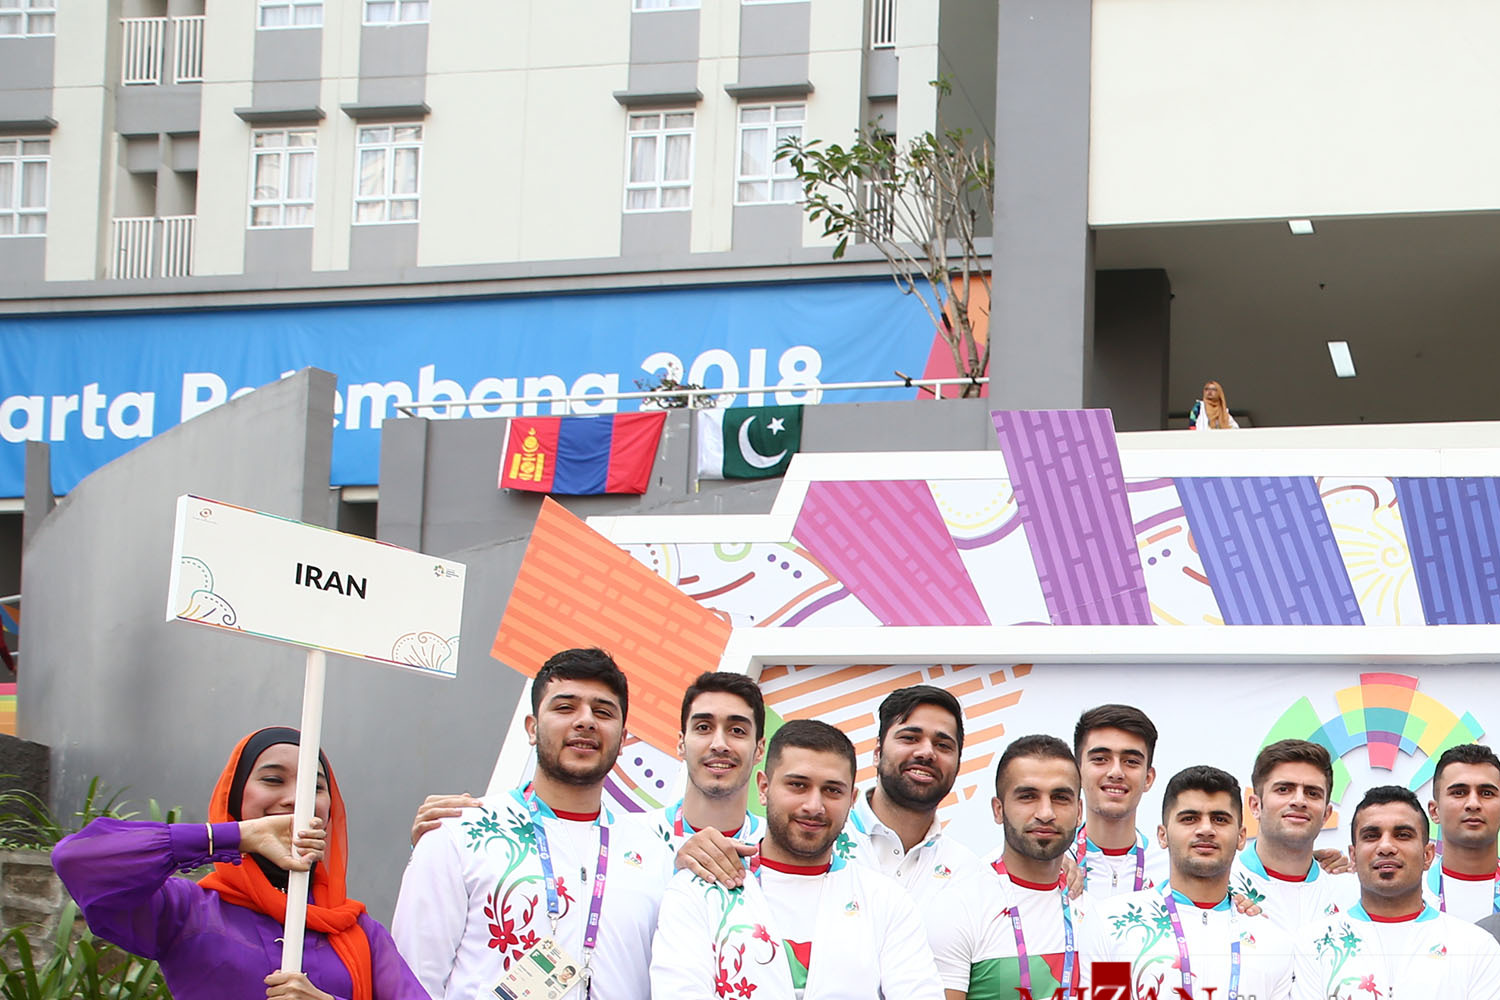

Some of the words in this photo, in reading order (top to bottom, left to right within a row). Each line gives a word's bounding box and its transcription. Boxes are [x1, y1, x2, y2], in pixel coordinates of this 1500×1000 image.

[181, 364, 619, 430] Pmbang
[640, 346, 823, 411] 2018
[295, 562, 368, 600] IRAN
